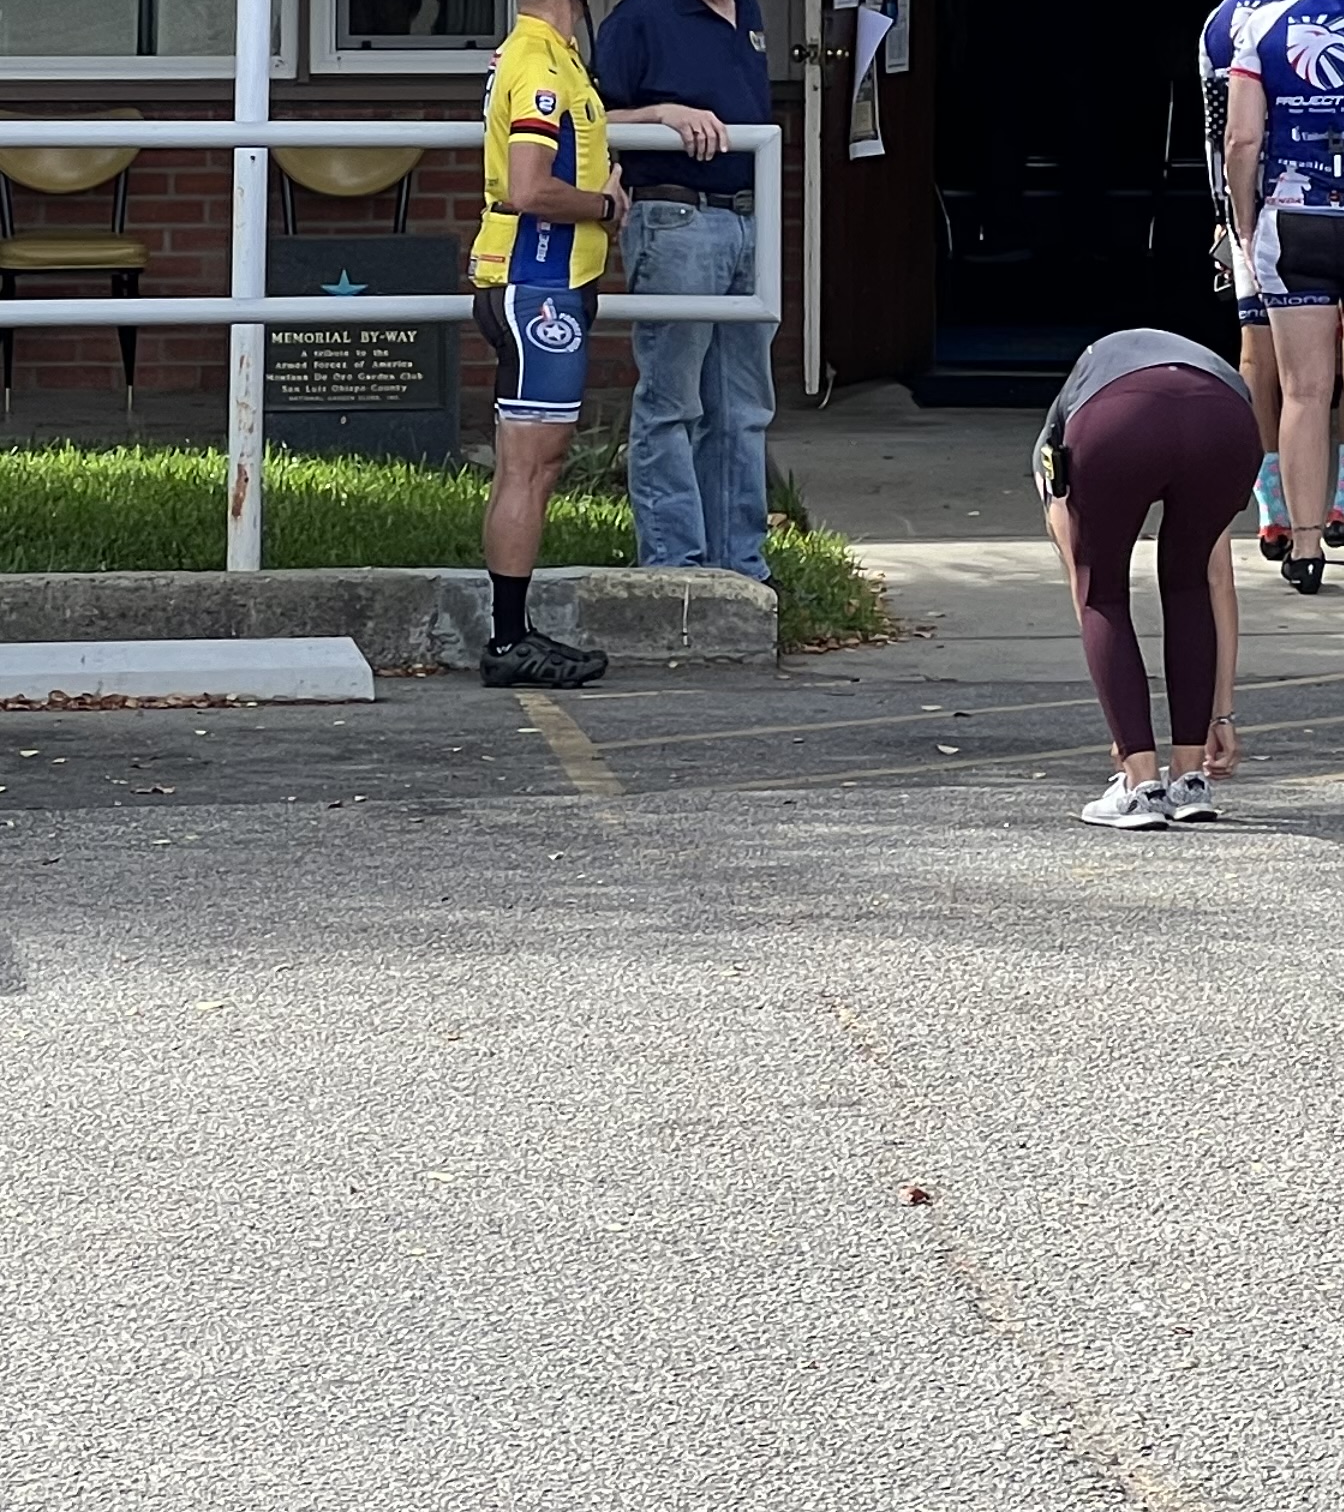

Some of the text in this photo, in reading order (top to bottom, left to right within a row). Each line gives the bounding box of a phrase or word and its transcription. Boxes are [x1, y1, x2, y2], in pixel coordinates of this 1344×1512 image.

[1275, 95, 1344, 106] PROJECT
[271, 330, 418, 344] MEMORIAL BY-WAY
[373, 349, 389, 357] the
[275, 360, 413, 369] Armed Forces of America
[358, 373, 396, 381] Garden
[400, 373, 424, 381] Club
[282, 385, 301, 393] San
[306, 385, 327, 393] Luis
[371, 385, 408, 393] County
